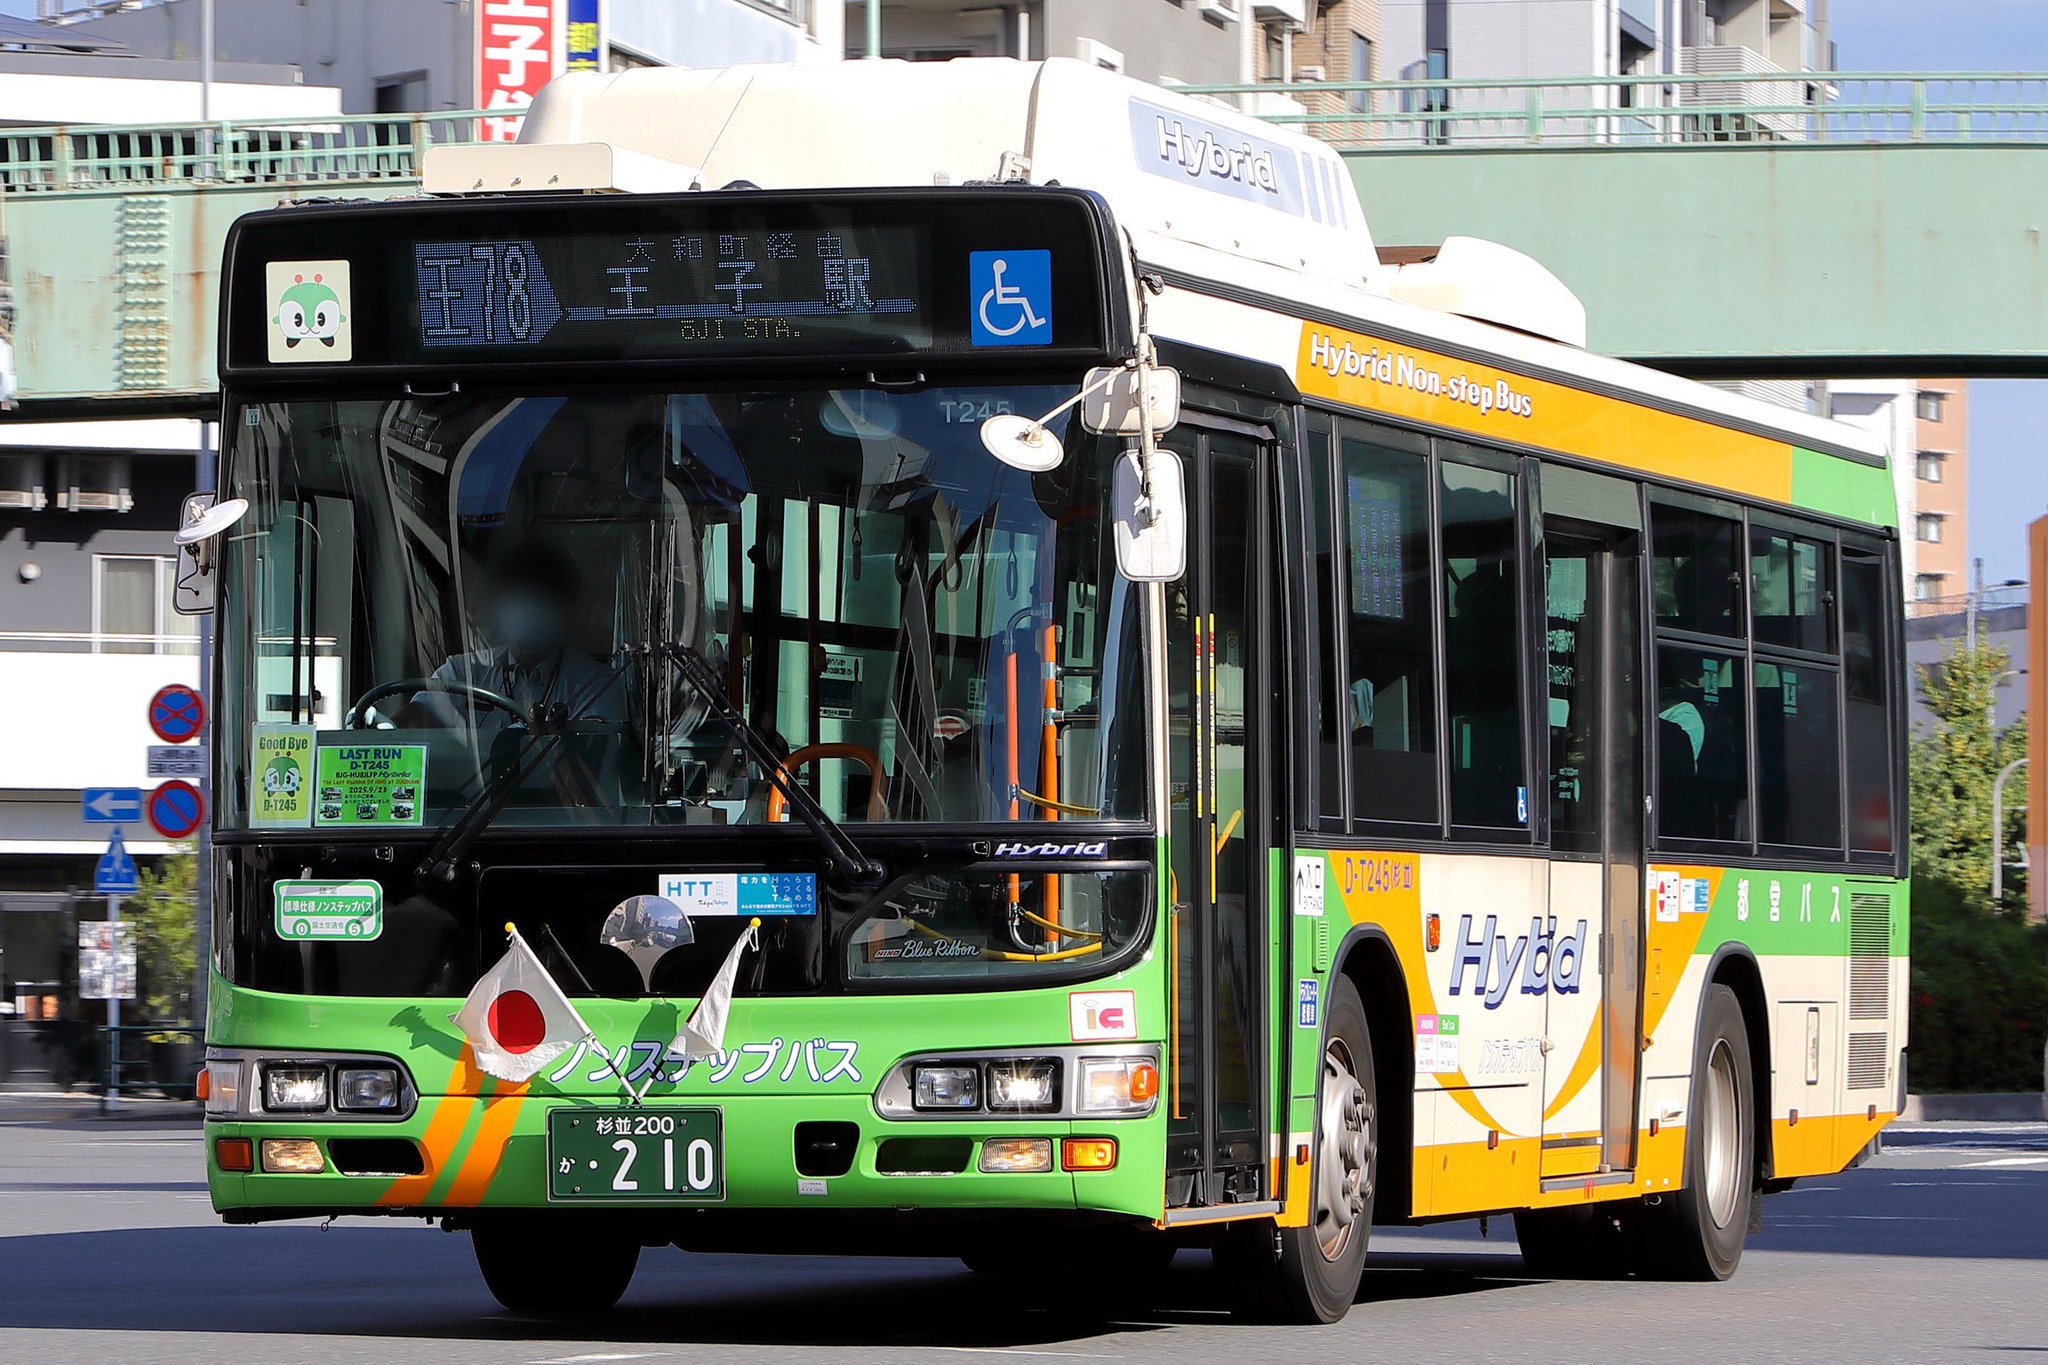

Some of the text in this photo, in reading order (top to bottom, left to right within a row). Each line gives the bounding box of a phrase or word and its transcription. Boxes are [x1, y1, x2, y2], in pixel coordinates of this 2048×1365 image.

[1157, 115, 1278, 194] Hybrid
[625, 232, 843, 262] 大和町経由
[424, 244, 530, 340] 王78
[606, 258, 875, 314] 王子駅
[744, 317, 800, 338] STA.
[1311, 333, 1533, 417] Hybrid Non-step Bus
[259, 736, 308, 750] Good Bye
[340, 748, 402, 760] LAST RUN
[350, 760, 390, 770] D-T245
[378, 771, 411, 779] Hybrid
[349, 786, 387, 794] 2025.9/23
[263, 799, 297, 812] D-T245
[995, 842, 1105, 857] Hybrid
[667, 881, 713, 897] HTT
[284, 900, 372, 913] 標準仕様ノンステップバス
[1736, 878, 1841, 922] 都営バス
[901, 939, 934, 958] Blue
[934, 938, 982, 957] Ribbon
[550, 1037, 862, 1083] ノンステップバス
[596, 1116, 674, 1135] 杉並200
[558, 1157, 575, 1174] か
